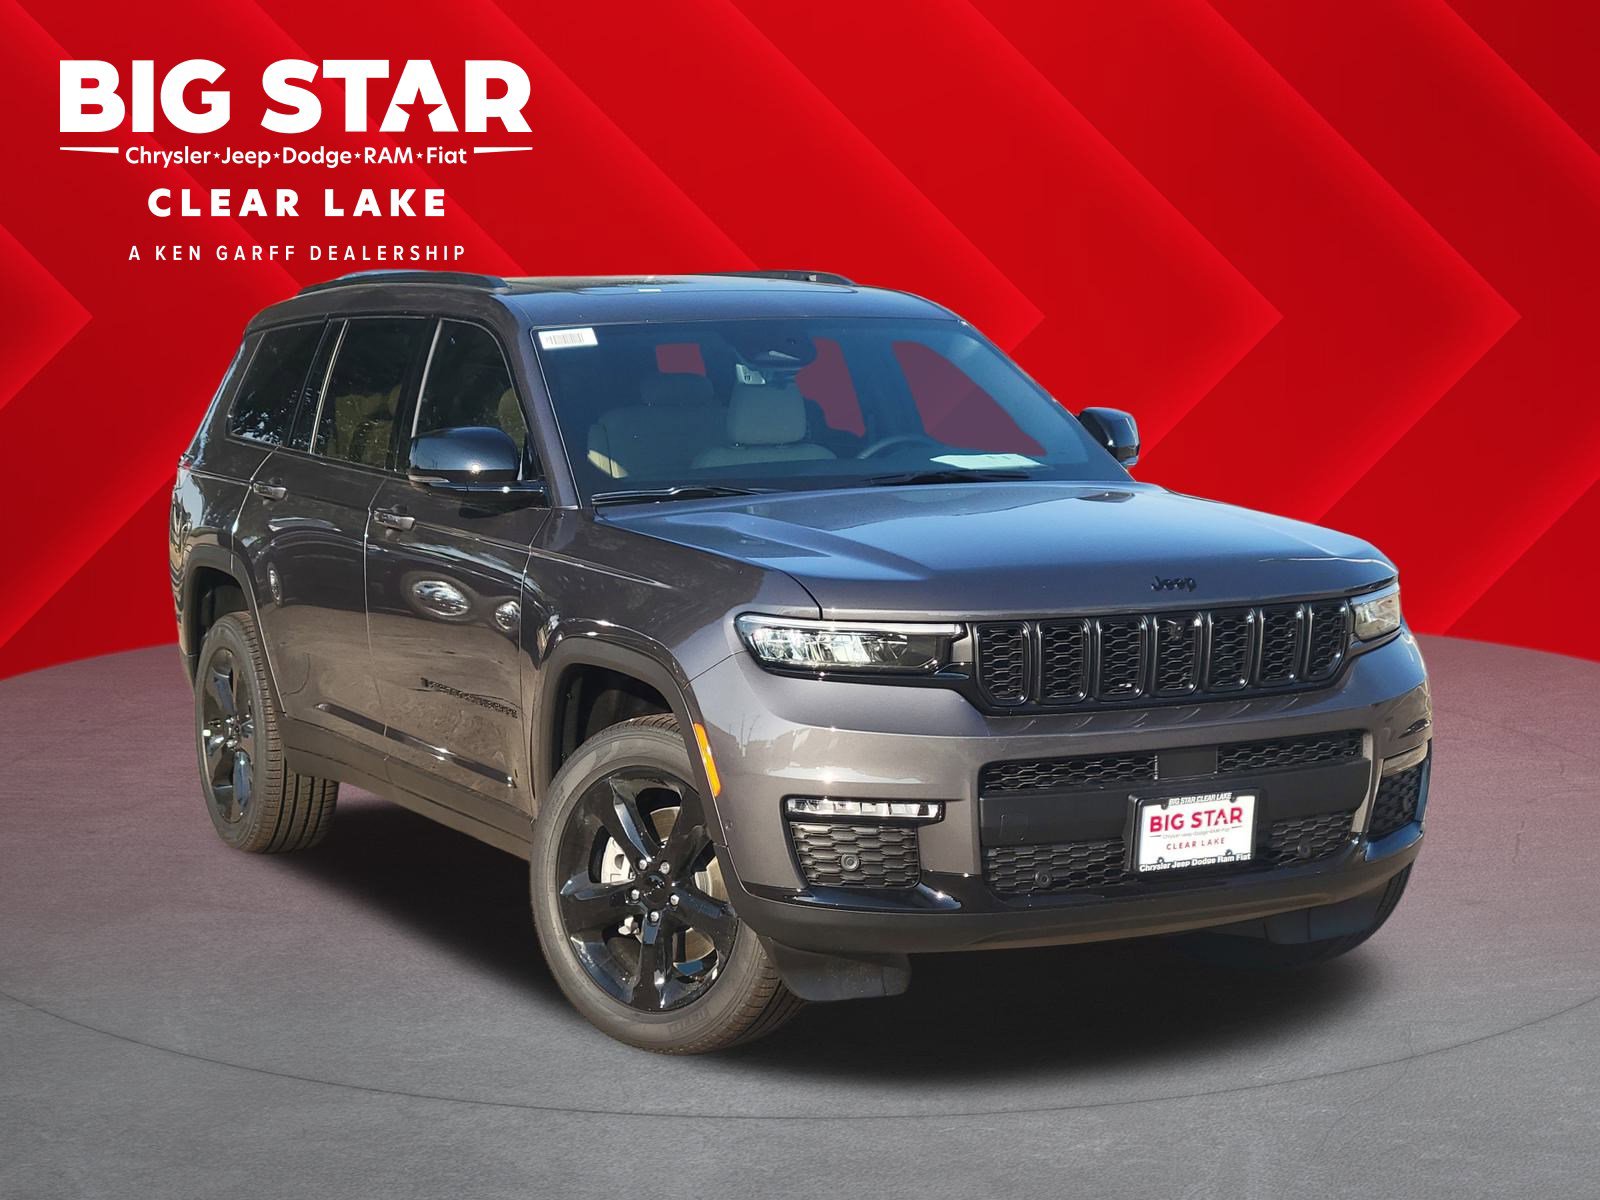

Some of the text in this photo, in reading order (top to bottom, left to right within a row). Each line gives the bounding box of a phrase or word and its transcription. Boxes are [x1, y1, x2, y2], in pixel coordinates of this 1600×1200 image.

[1151, 576, 1197, 593] Jeep
[1150, 807, 1243, 833] BIG STAR
[1166, 837, 1225, 850] CLEAR LAKE
[1139, 853, 1251, 873] Chrysler Jeep Dodge Ram Fiat
